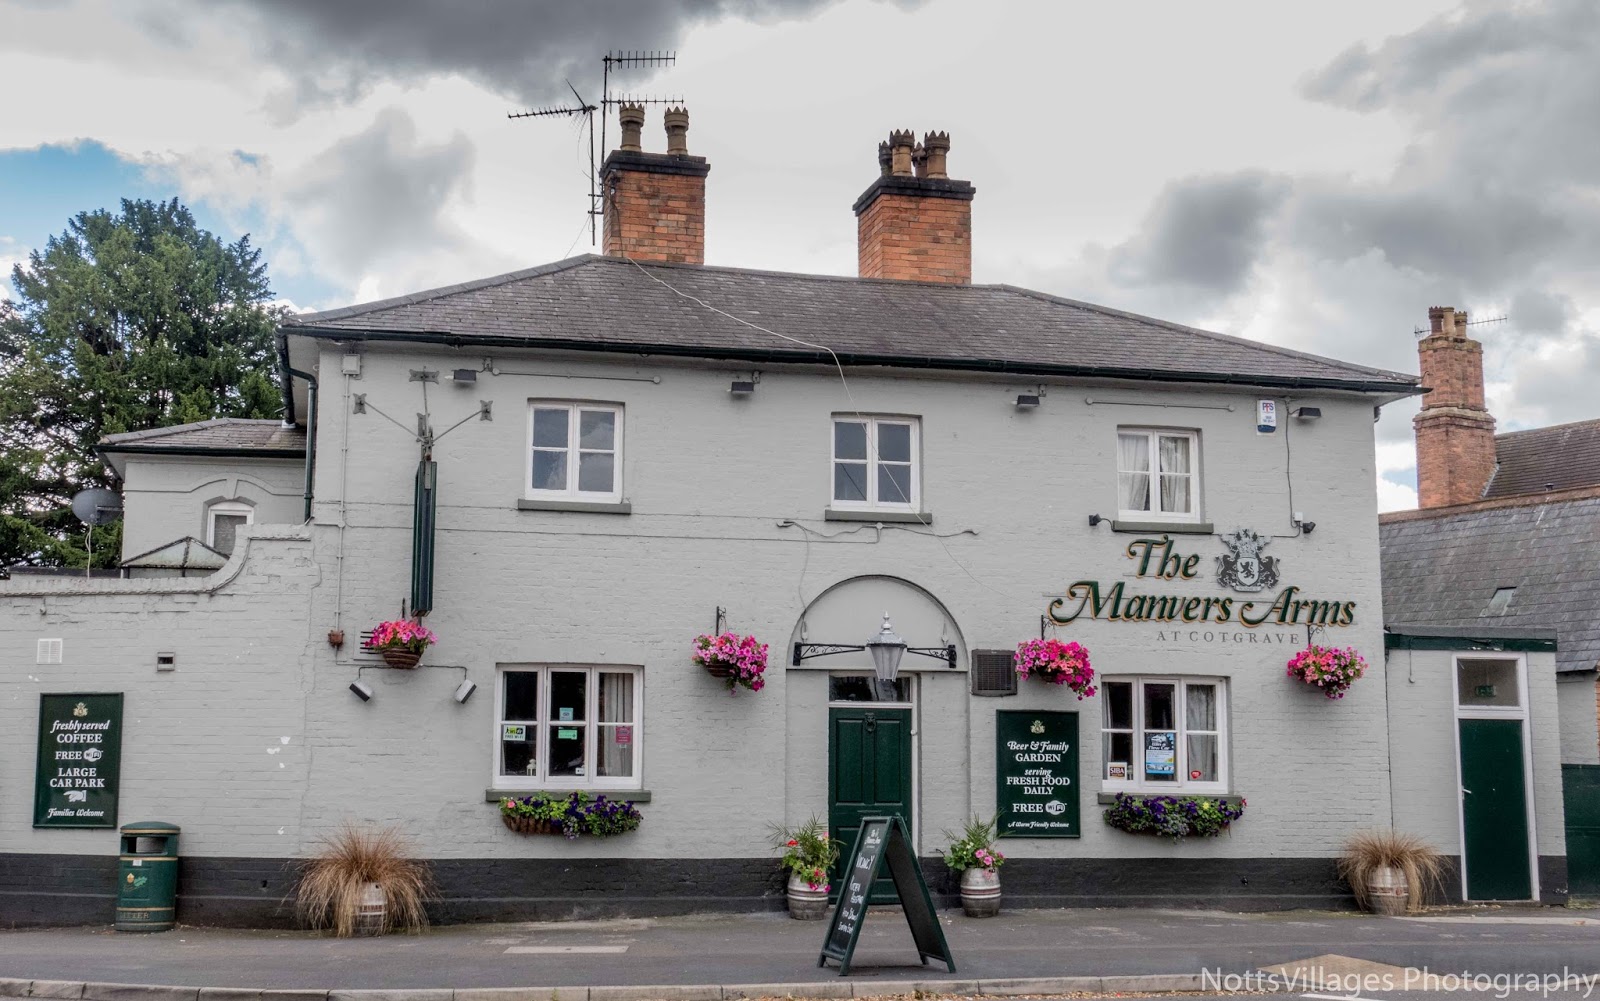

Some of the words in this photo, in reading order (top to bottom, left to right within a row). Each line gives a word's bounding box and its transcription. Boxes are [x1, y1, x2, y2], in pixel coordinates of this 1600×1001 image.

[1126, 534, 1200, 580] The
[1047, 580, 1233, 627] Manvers
[1238, 585, 1357, 628] Arms
[1156, 631, 1181, 642] AT
[1189, 631, 1300, 645] COTGRAVE
[50, 720, 82, 733] freshly
[82, 720, 110, 730] served
[56, 733, 103, 743] COFFEE
[1007, 741, 1029, 750] Beer
[1029, 741, 1039, 750] &
[1039, 741, 1069, 754] Family
[55, 751, 82, 760] FREE
[1015, 753, 1061, 762] GARDEN
[58, 767, 97, 777] LARGE
[1024, 767, 1052, 779] serving
[49, 778, 73, 788] CAR
[75, 778, 105, 788] PARK
[1006, 776, 1040, 785] FRESH
[1041, 777, 1070, 785] FOOD
[1023, 786, 1054, 795] DAILY
[47, 808, 75, 818] Families
[76, 808, 104, 817] Welcome
[1012, 803, 1044, 813] FREE
